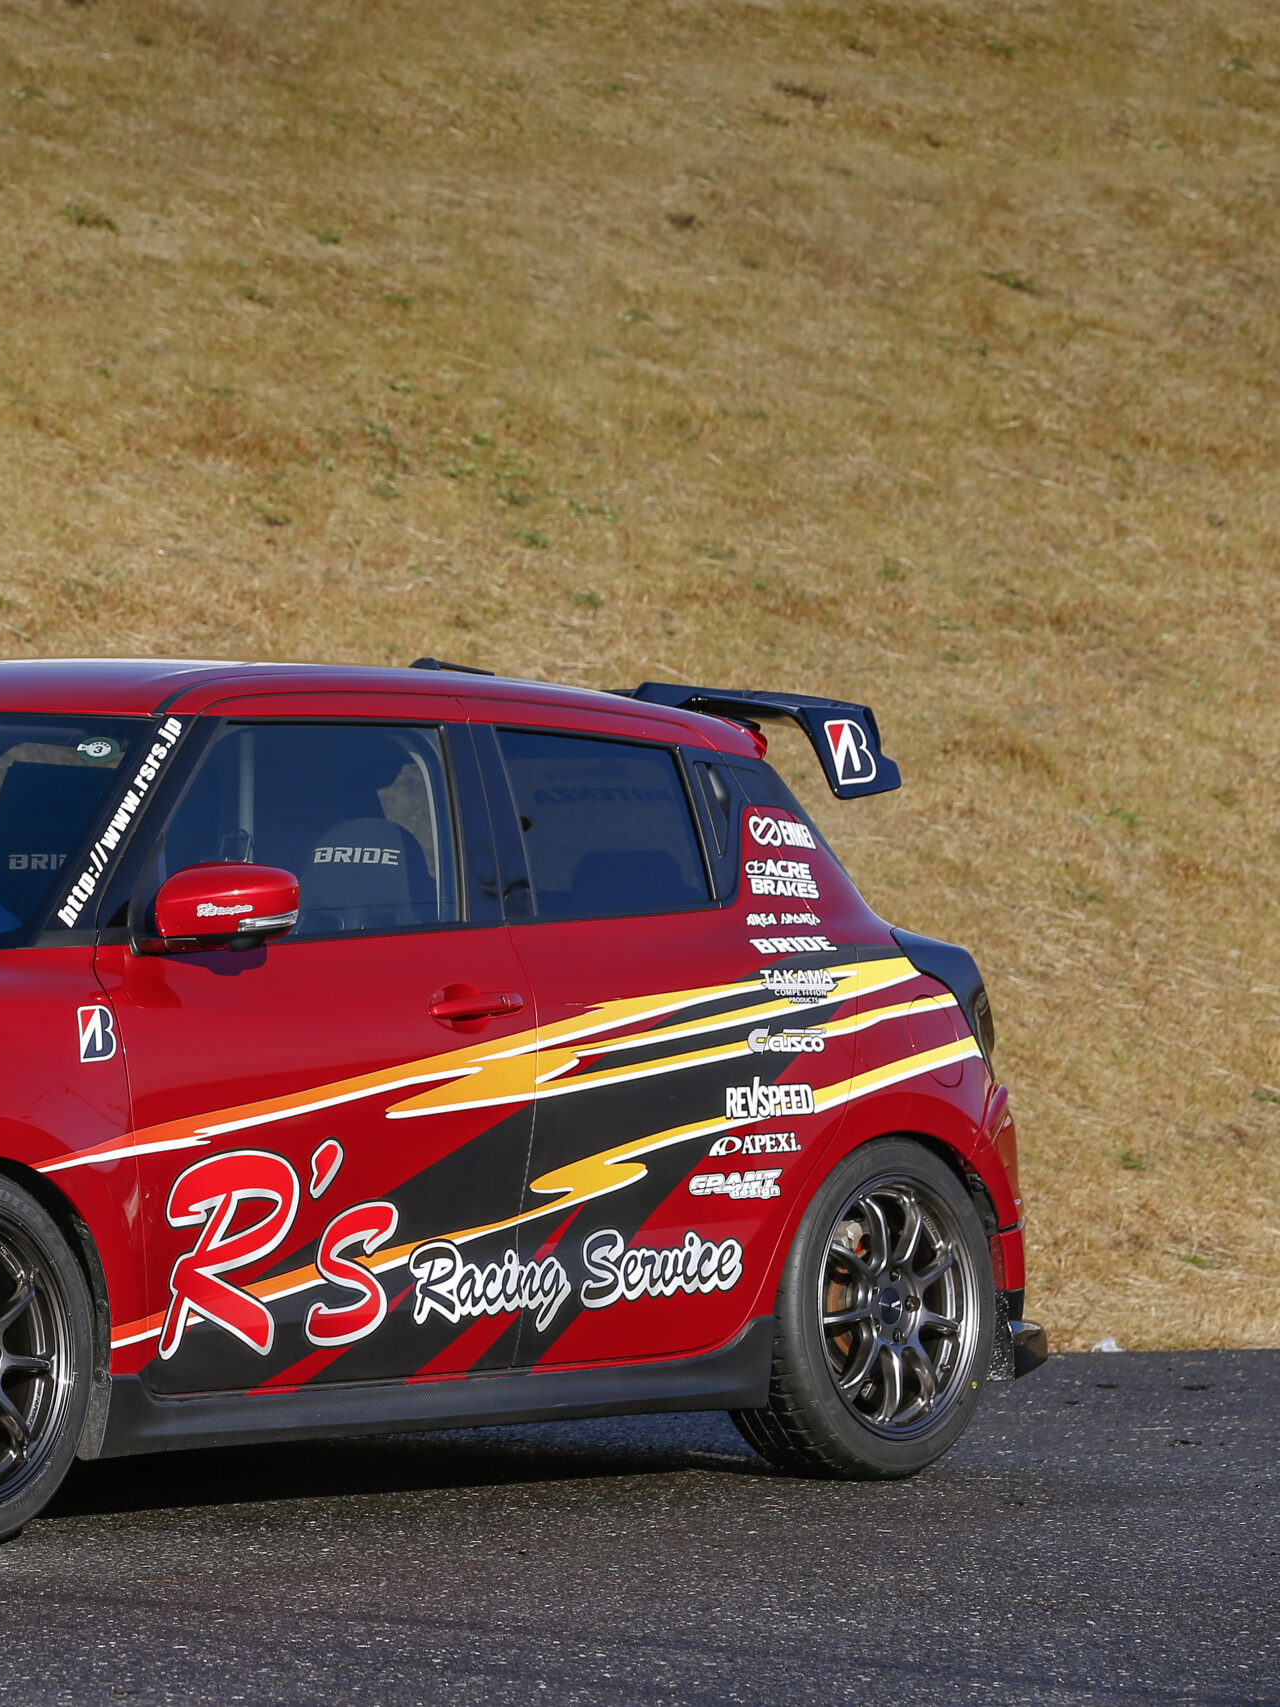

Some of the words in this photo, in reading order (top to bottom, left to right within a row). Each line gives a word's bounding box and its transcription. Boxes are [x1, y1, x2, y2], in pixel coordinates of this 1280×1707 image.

[57, 716, 183, 928] http://www.rsrs.jp
[312, 846, 401, 866] BRIDE
[764, 858, 812, 880] ACRE
[750, 879, 820, 899] BRAKES
[749, 936, 838, 954] BRIDE
[760, 969, 834, 984] TAKAMA
[774, 989, 827, 997] COMPETITION
[725, 1076, 815, 1119] REVSPEED
[689, 1169, 782, 1196] GRANT
[732, 1184, 781, 1199] design
[158, 1137, 399, 1361] R's
[410, 1238, 571, 1332] Racing
[579, 1228, 744, 1308] Service
